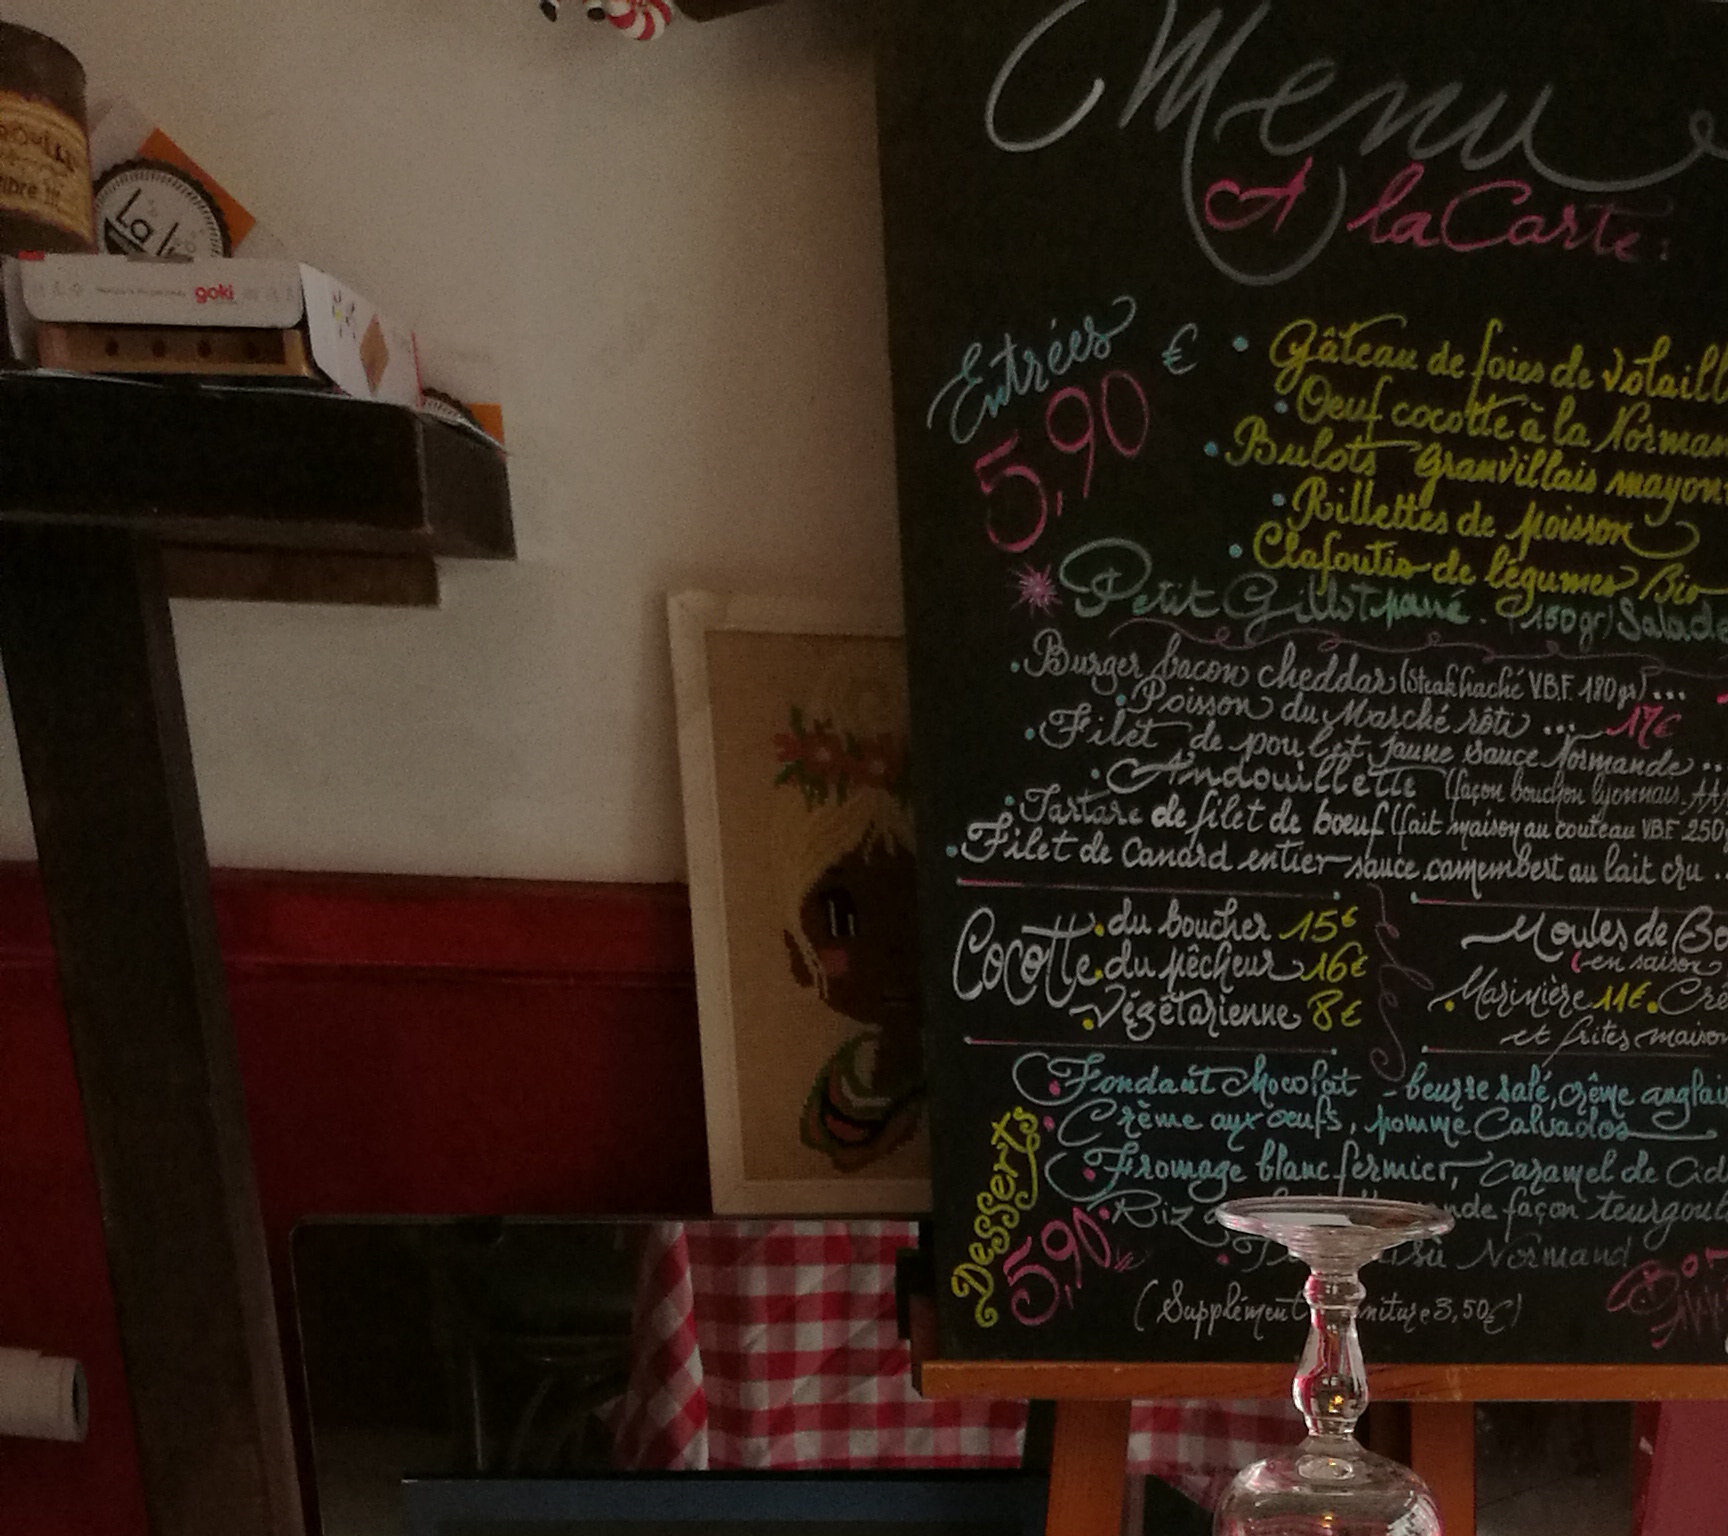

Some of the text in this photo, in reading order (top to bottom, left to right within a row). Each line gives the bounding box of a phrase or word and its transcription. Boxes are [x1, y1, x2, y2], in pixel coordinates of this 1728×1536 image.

[193, 283, 235, 304] goki
[1270, 313, 1418, 395] Gâteau
[1427, 342, 1465, 381] de
[1467, 317, 1545, 418] foies
[1550, 344, 1593, 391] de
[1223, 414, 1422, 476] Bulots
[1392, 393, 1531, 441] cocotte
[1519, 402, 1545, 438] à
[1552, 398, 1591, 449] la
[1285, 477, 1699, 560] Rillettes de poisson
[1058, 536, 1222, 619] Petit
[1253, 521, 1433, 596] Clafoutis
[1432, 548, 1476, 586] de
[1023, 627, 1141, 697] Burger
[1141, 632, 1249, 687] bacon
[1256, 640, 1399, 695] cheddar
[1125, 677, 1274, 722] Poisson
[1280, 691, 1319, 726] du
[1038, 701, 1192, 751] Filet
[1190, 719, 1224, 753] de
[1463, 741, 1539, 771] sauce
[1018, 782, 1144, 828] Tartare
[1150, 793, 1189, 830] de
[1186, 789, 1265, 847] filet
[1268, 801, 1302, 836] de
[1523, 820, 1549, 839] au
[1553, 813, 1636, 840] couteau
[958, 810, 1079, 864] Filet
[1079, 830, 1113, 866] de
[1236, 839, 1353, 877] entier
[1344, 854, 1421, 882] sauce
[1422, 840, 1567, 900] camembert
[1567, 864, 1600, 885] au
[1604, 843, 1657, 885] lait
[1106, 897, 1152, 940] du
[1157, 896, 1273, 944] boucher
[1459, 906, 1630, 964] Moules
[1633, 905, 1669, 950] de
[1103, 940, 1156, 982] du
[1157, 940, 1304, 995] pêcheur
[1255, 1138, 1332, 1182] blanc
[1620, 1150, 1658, 1185] de
